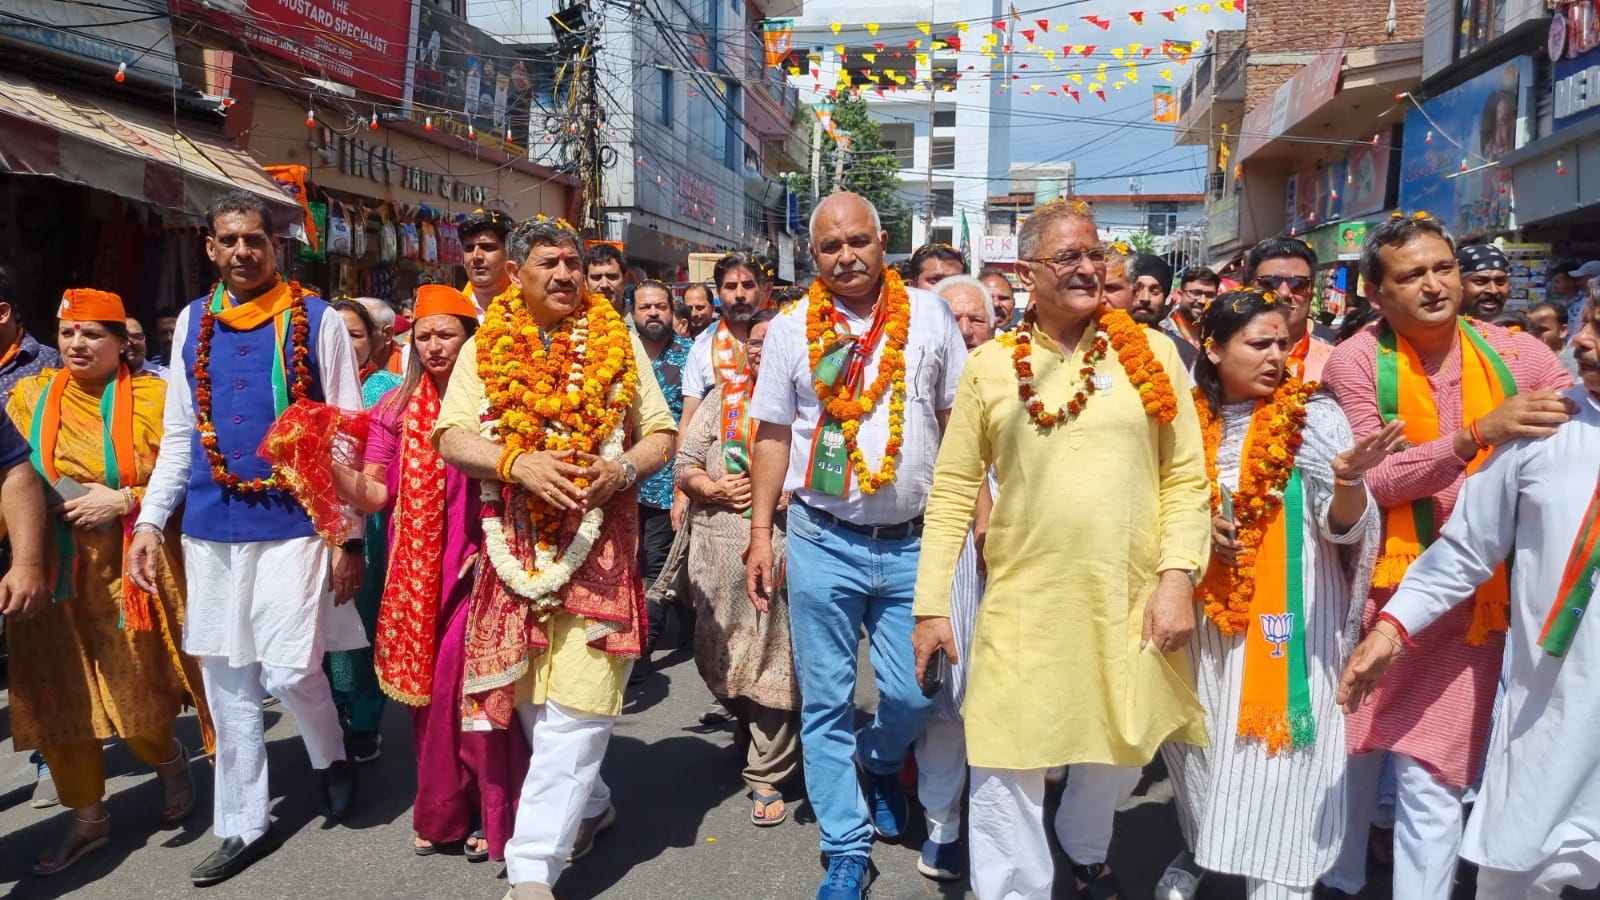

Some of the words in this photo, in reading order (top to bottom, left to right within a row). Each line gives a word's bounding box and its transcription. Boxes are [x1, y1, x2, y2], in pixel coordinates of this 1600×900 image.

[331, 0, 349, 16] THE
[277, 0, 333, 28] MUSTARD
[334, 17, 388, 55] SPECIALIST
[984, 238, 995, 251] R
[1001, 238, 1012, 251] K
